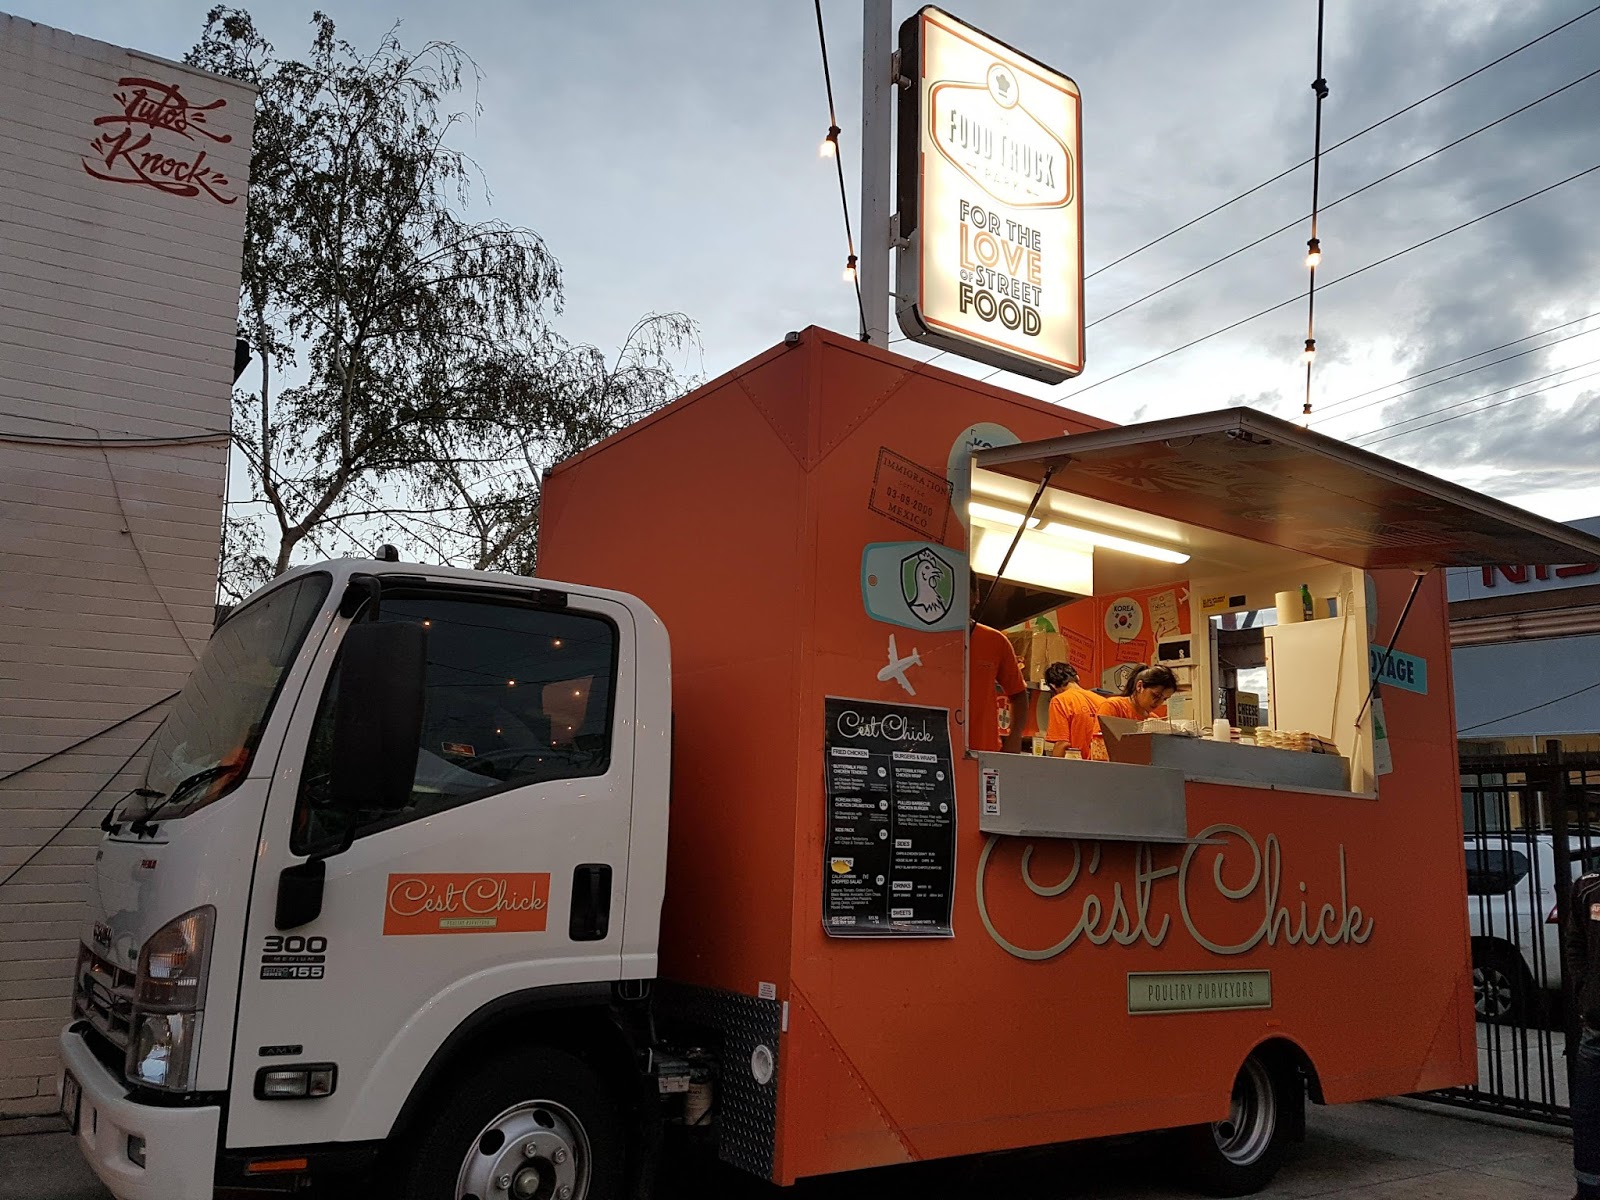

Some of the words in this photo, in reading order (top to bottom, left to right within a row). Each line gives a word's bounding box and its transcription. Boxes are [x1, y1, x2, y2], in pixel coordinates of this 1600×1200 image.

[82, 127, 238, 204] Knock
[960, 199, 1001, 236] FOR
[1006, 219, 1041, 252] THE
[960, 222, 1042, 286] LOVE
[960, 269, 973, 283] OF
[975, 265, 1042, 307] STREET
[959, 281, 1042, 337] FOOD
[883, 457, 948, 496] IMMIGRATION
[888, 502, 928, 528] MEXICO
[837, 710, 882, 739] C'est
[881, 713, 934, 742] Chick
[1238, 702, 1259, 717] CHEESE
[389, 878, 464, 916] C'est
[462, 877, 546, 914] Chick
[1178, 823, 1374, 955] Chick
[262, 935, 328, 953] 300
[289, 966, 323, 977] 155
[1148, 984, 1193, 1002] POULTRY
[1197, 981, 1254, 1000] PURVEYORS
[265, 1047, 296, 1055] AMT
